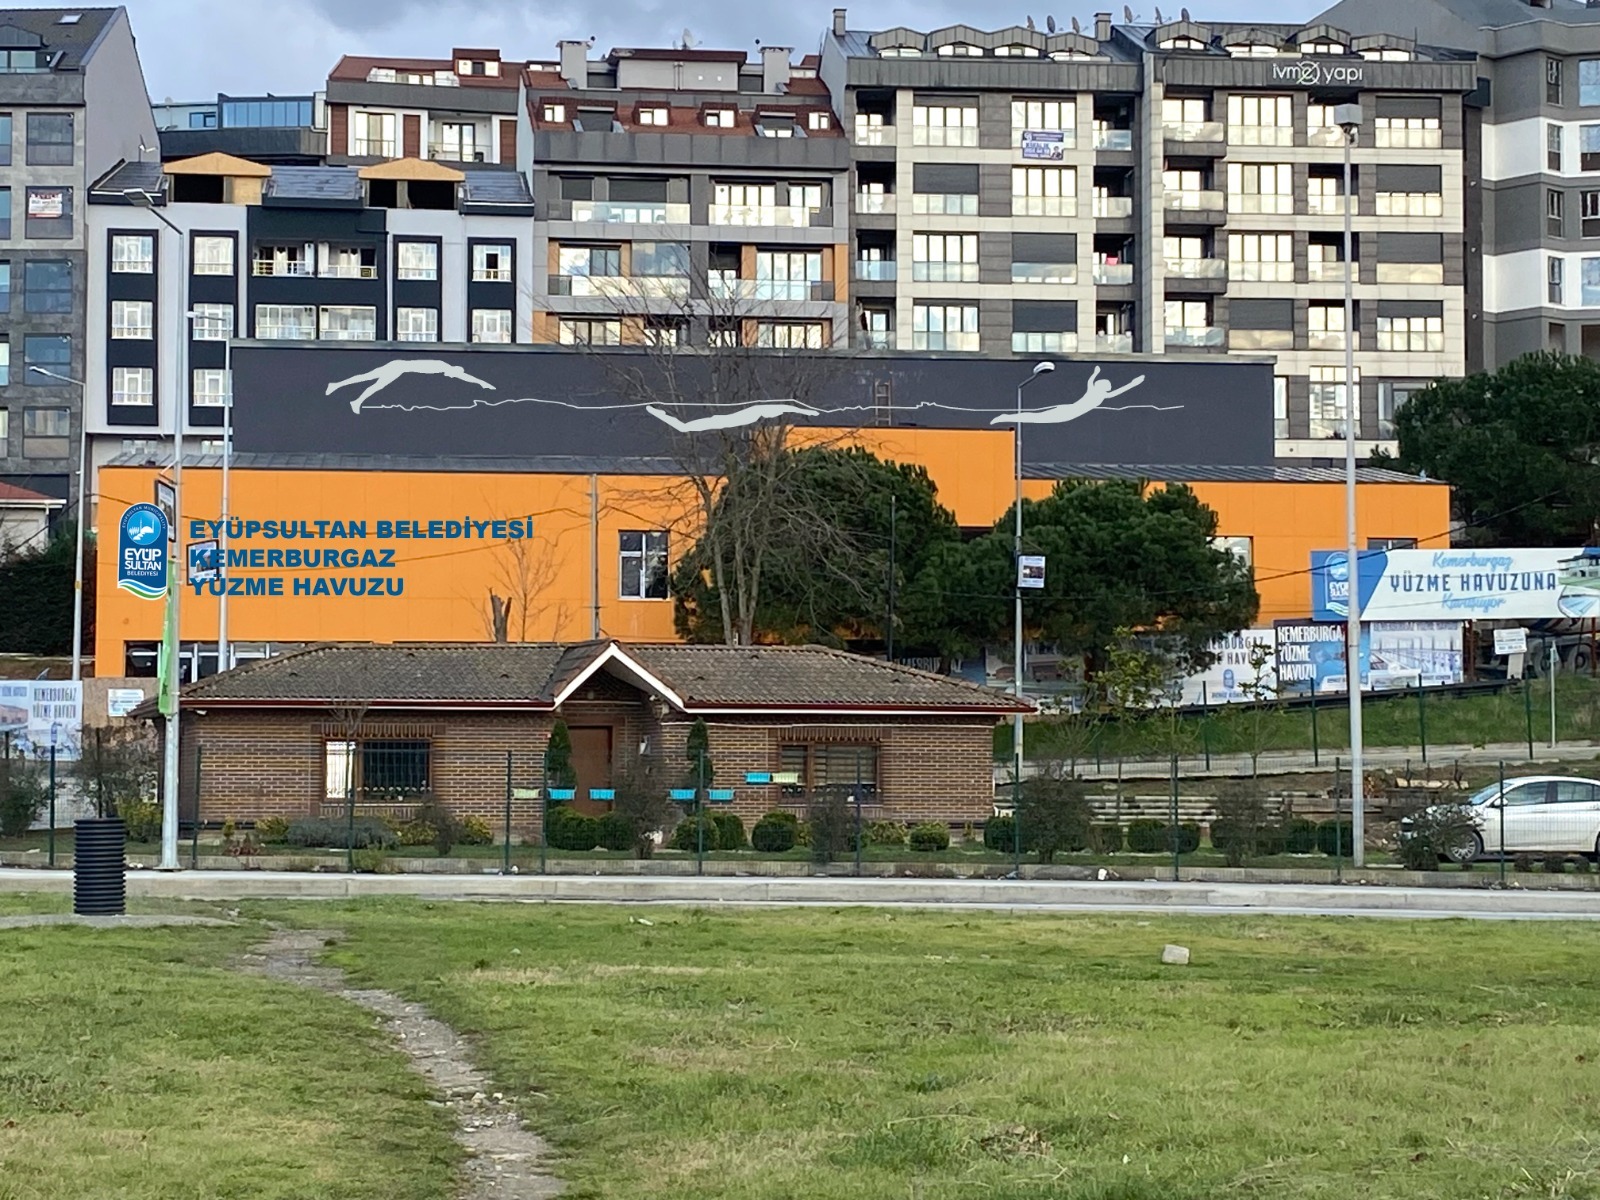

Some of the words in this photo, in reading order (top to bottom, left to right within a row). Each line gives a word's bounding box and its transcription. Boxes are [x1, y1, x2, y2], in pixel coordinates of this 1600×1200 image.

[1323, 67, 1362, 84] yapı
[1432, 552, 1513, 571] Kemerburgaz
[1390, 570, 1450, 592] YÜZME
[1461, 573, 1556, 592] HAVUZUNA
[1278, 643, 1311, 662] YÜZME
[1279, 664, 1317, 681] HAVUZU
